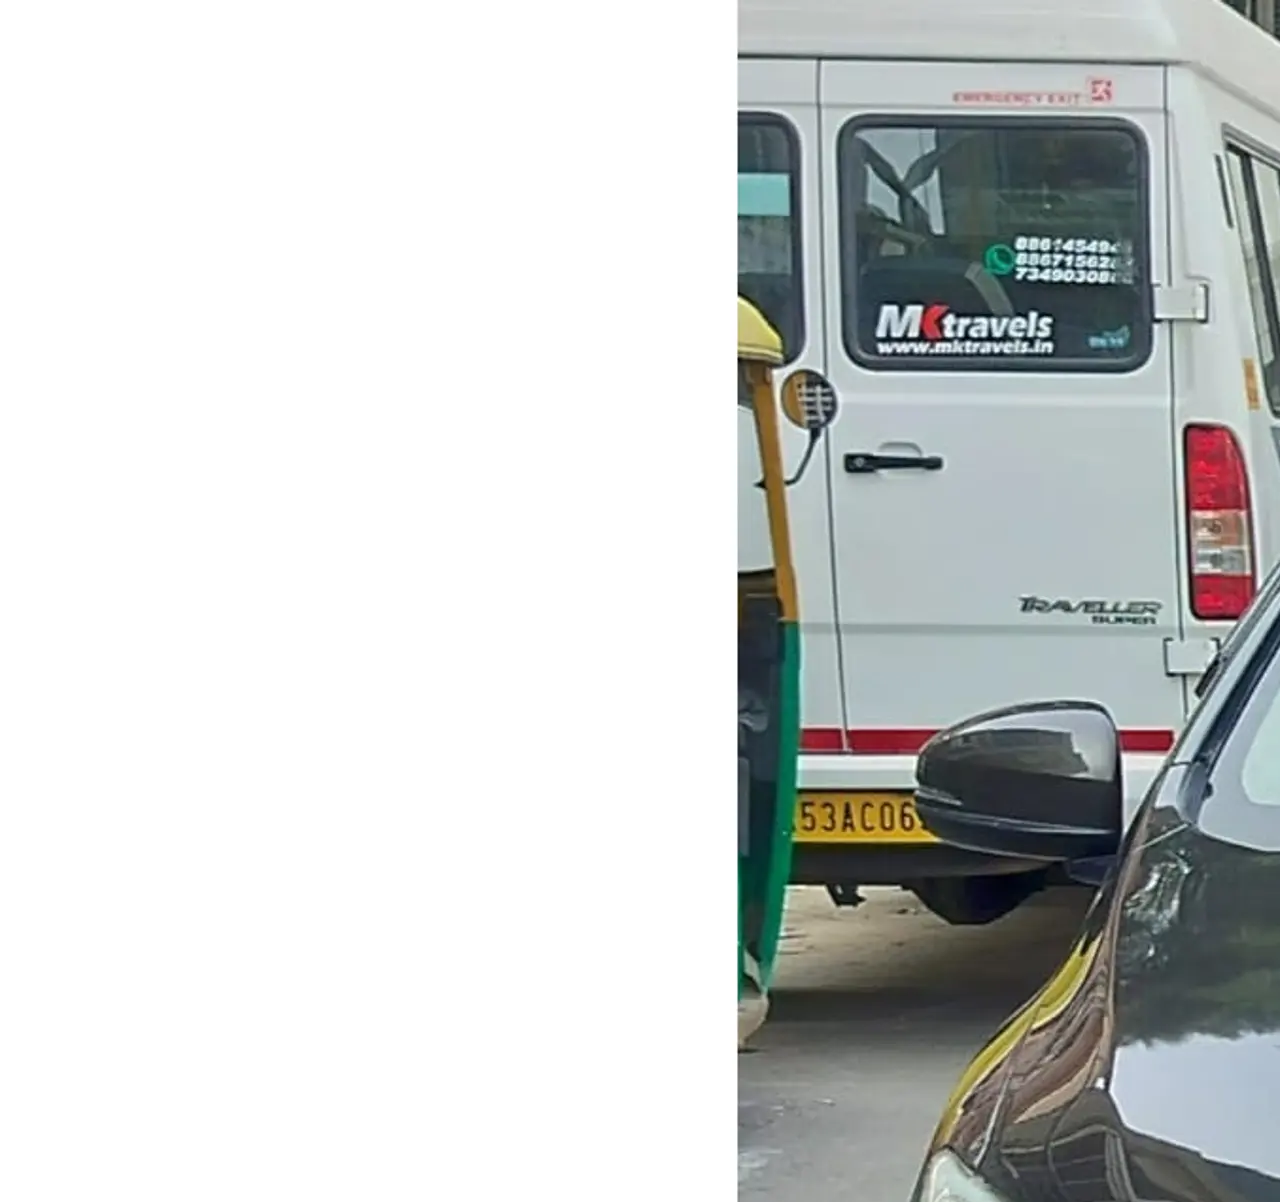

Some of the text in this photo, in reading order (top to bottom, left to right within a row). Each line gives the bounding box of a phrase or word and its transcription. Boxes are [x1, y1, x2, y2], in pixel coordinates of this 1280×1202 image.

[876, 340, 1054, 354] www.mktravels.in
[1018, 597, 1163, 614] TRAVELLER
[1092, 615, 1157, 625] SUPER
[793, 801, 925, 832] 53AC06
